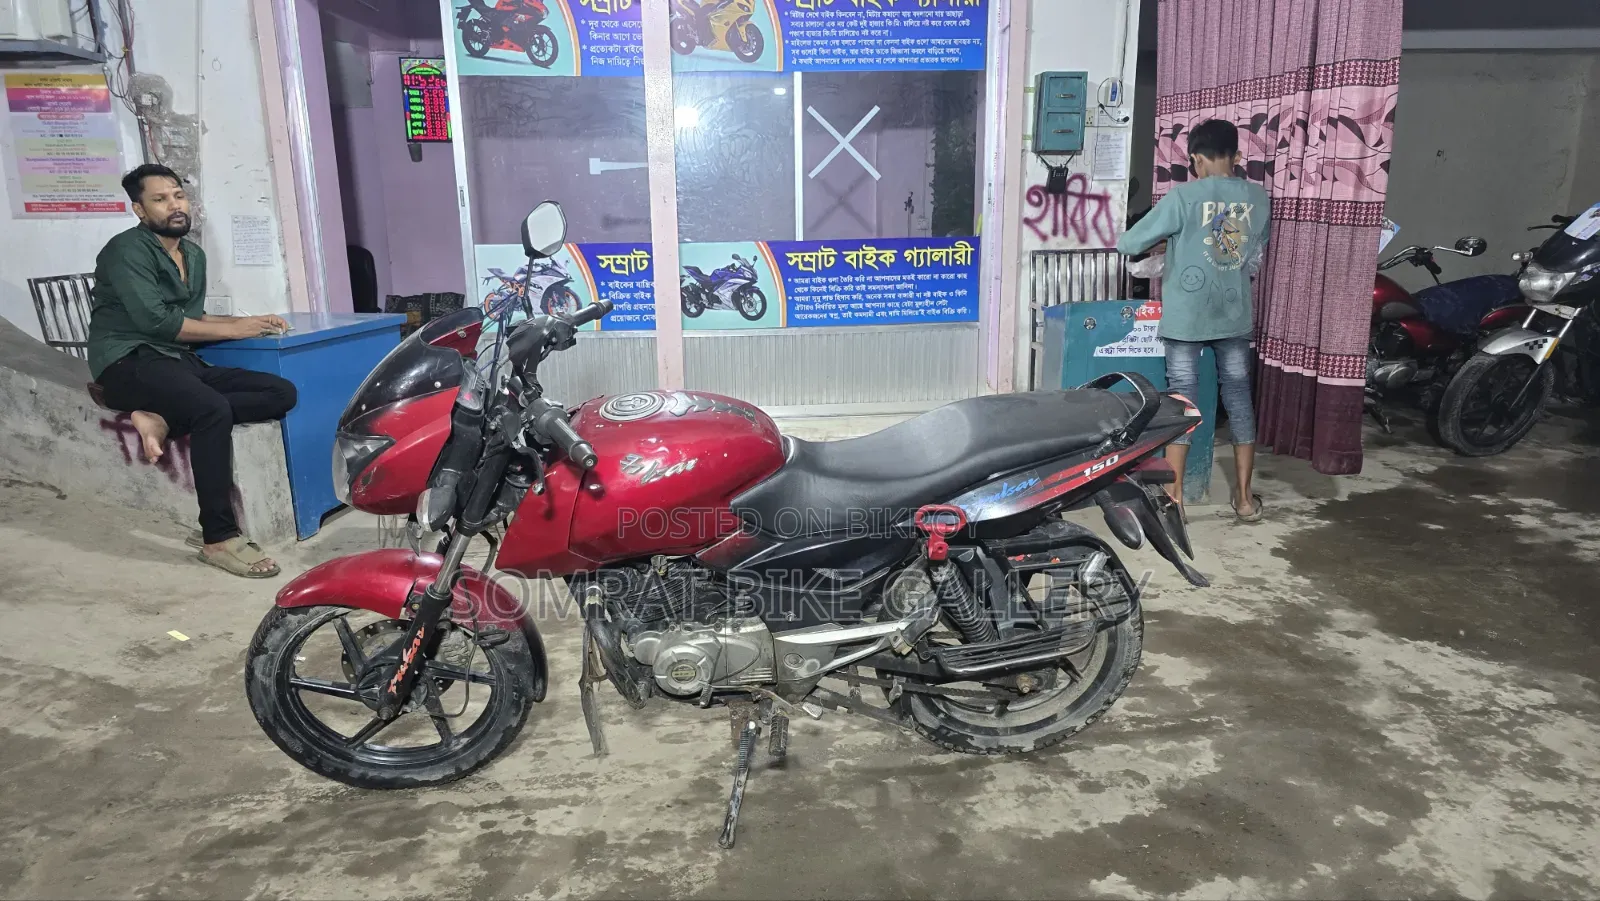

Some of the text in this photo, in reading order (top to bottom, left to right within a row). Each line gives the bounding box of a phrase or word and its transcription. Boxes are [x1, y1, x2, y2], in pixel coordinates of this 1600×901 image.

[622, 20, 642, 28] এসে
[1201, 201, 1254, 230] BMX
[596, 248, 651, 276] সম্রাট
[785, 241, 975, 273] সম্রাট বাইক গ্যালারী
[1084, 454, 1119, 476] 150
